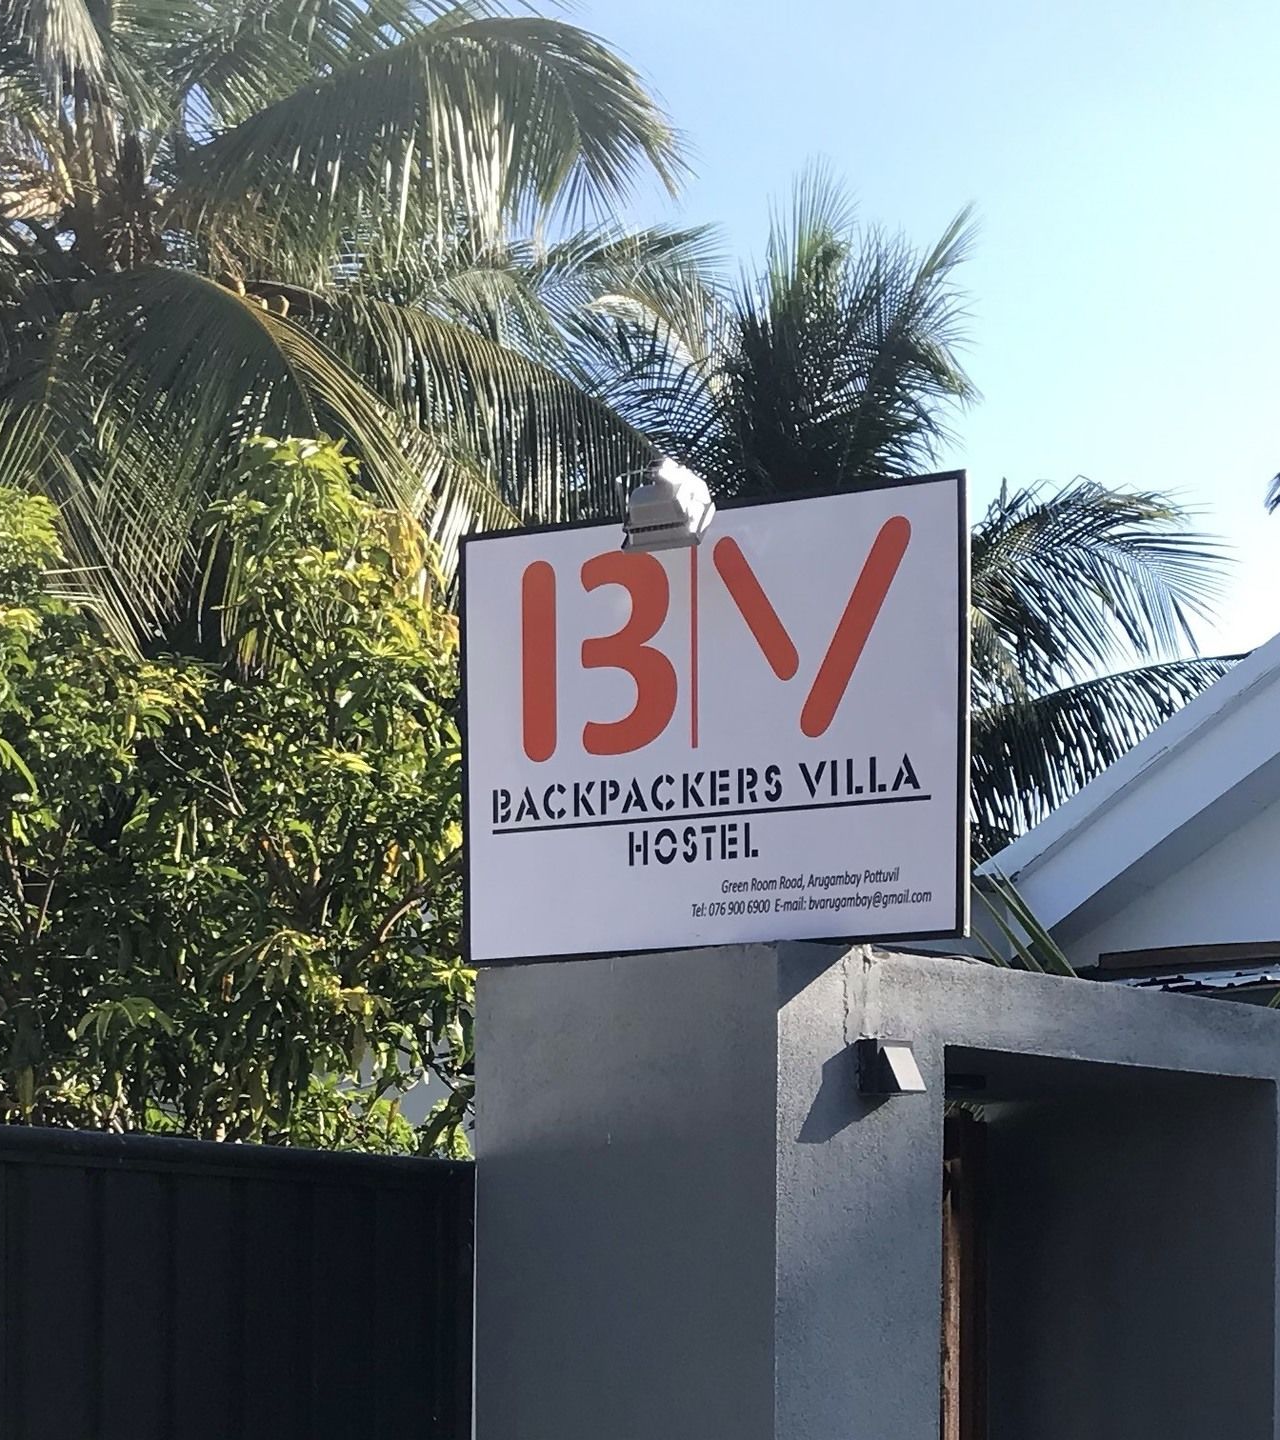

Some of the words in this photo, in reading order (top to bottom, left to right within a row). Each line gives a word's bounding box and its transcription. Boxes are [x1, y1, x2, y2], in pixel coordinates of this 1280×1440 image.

[492, 764, 783, 824] BACKPACKERS
[798, 752, 921, 799] VILLA
[628, 822, 759, 866] HOSTEL
[721, 879, 749, 894] Green
[750, 877, 778, 892] Room
[779, 873, 806, 891] Road,
[807, 870, 862, 890] Arugambay
[863, 866, 900, 884] Pottuvil
[691, 902, 707, 918] Tel:
[708, 902, 726, 917] 076
[727, 899, 746, 916] 900
[747, 898, 771, 915] 6900
[774, 896, 807, 913] E-mail:
[808, 888, 933, 912] bvarugambay@gmail.com
